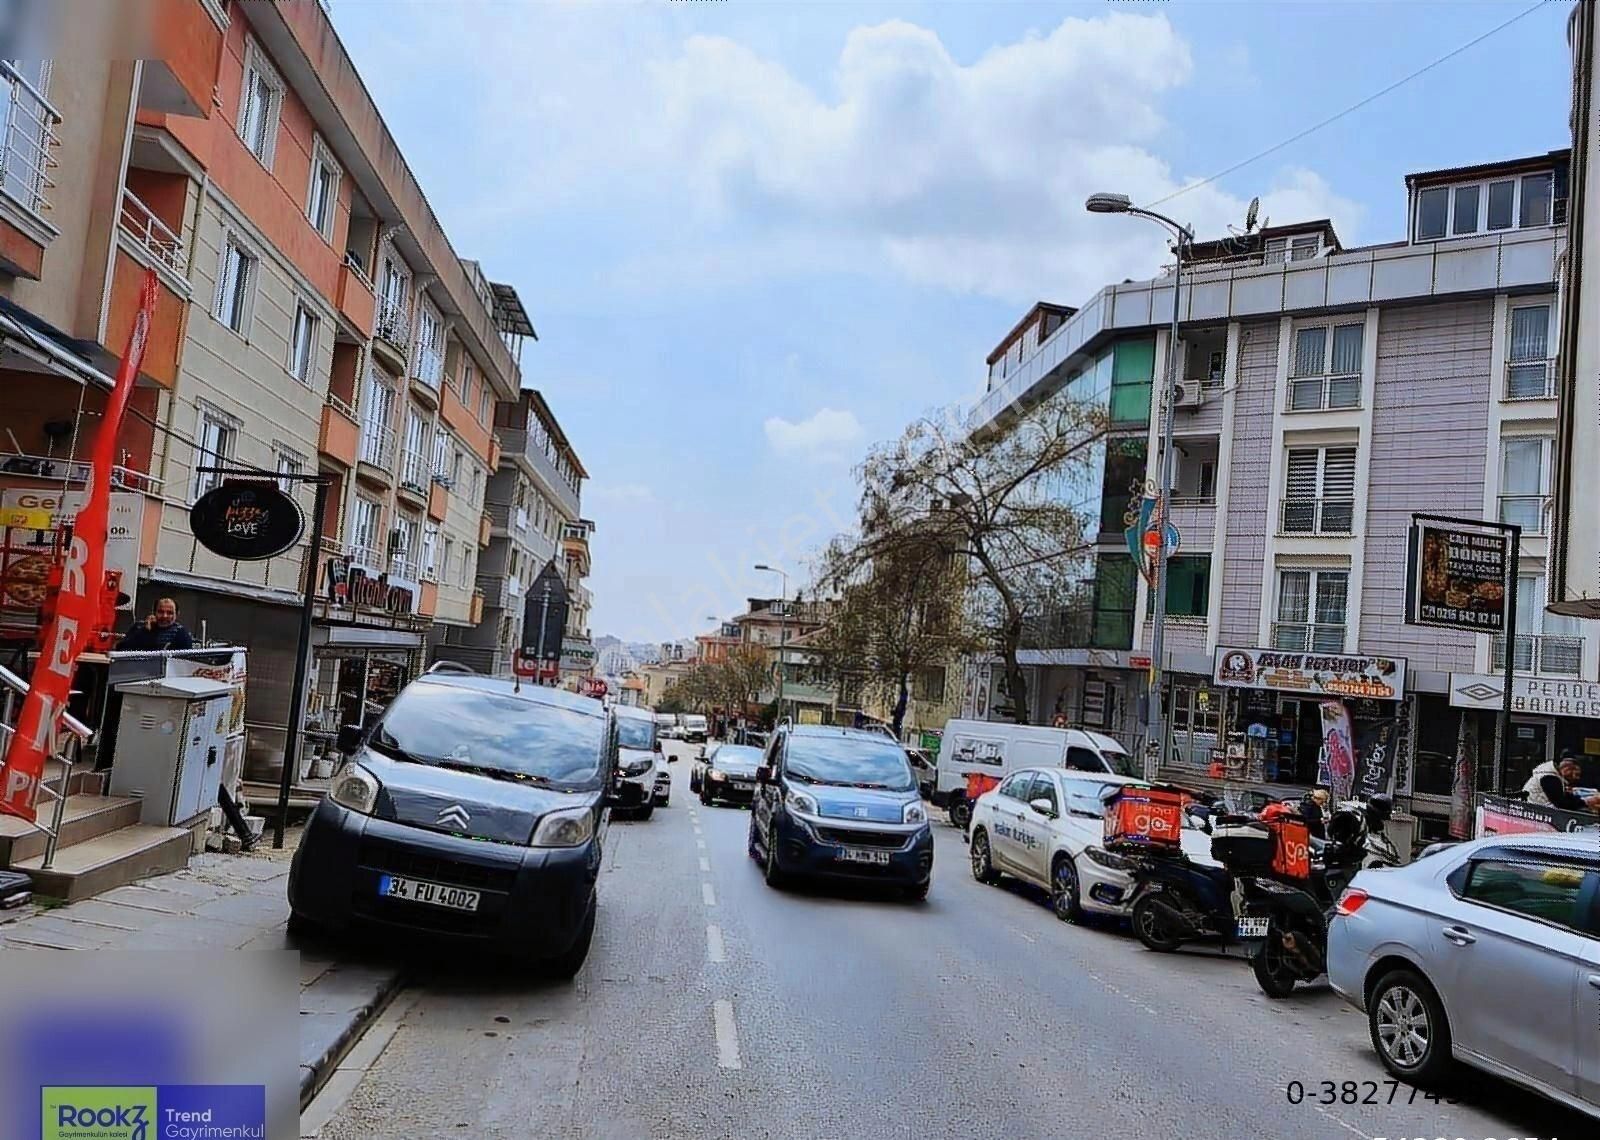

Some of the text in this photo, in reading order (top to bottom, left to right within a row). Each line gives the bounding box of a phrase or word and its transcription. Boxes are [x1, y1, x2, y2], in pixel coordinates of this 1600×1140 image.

[1528, 681, 1599, 699] PERDE
[389, 879, 477, 909] 34 FU 4002
